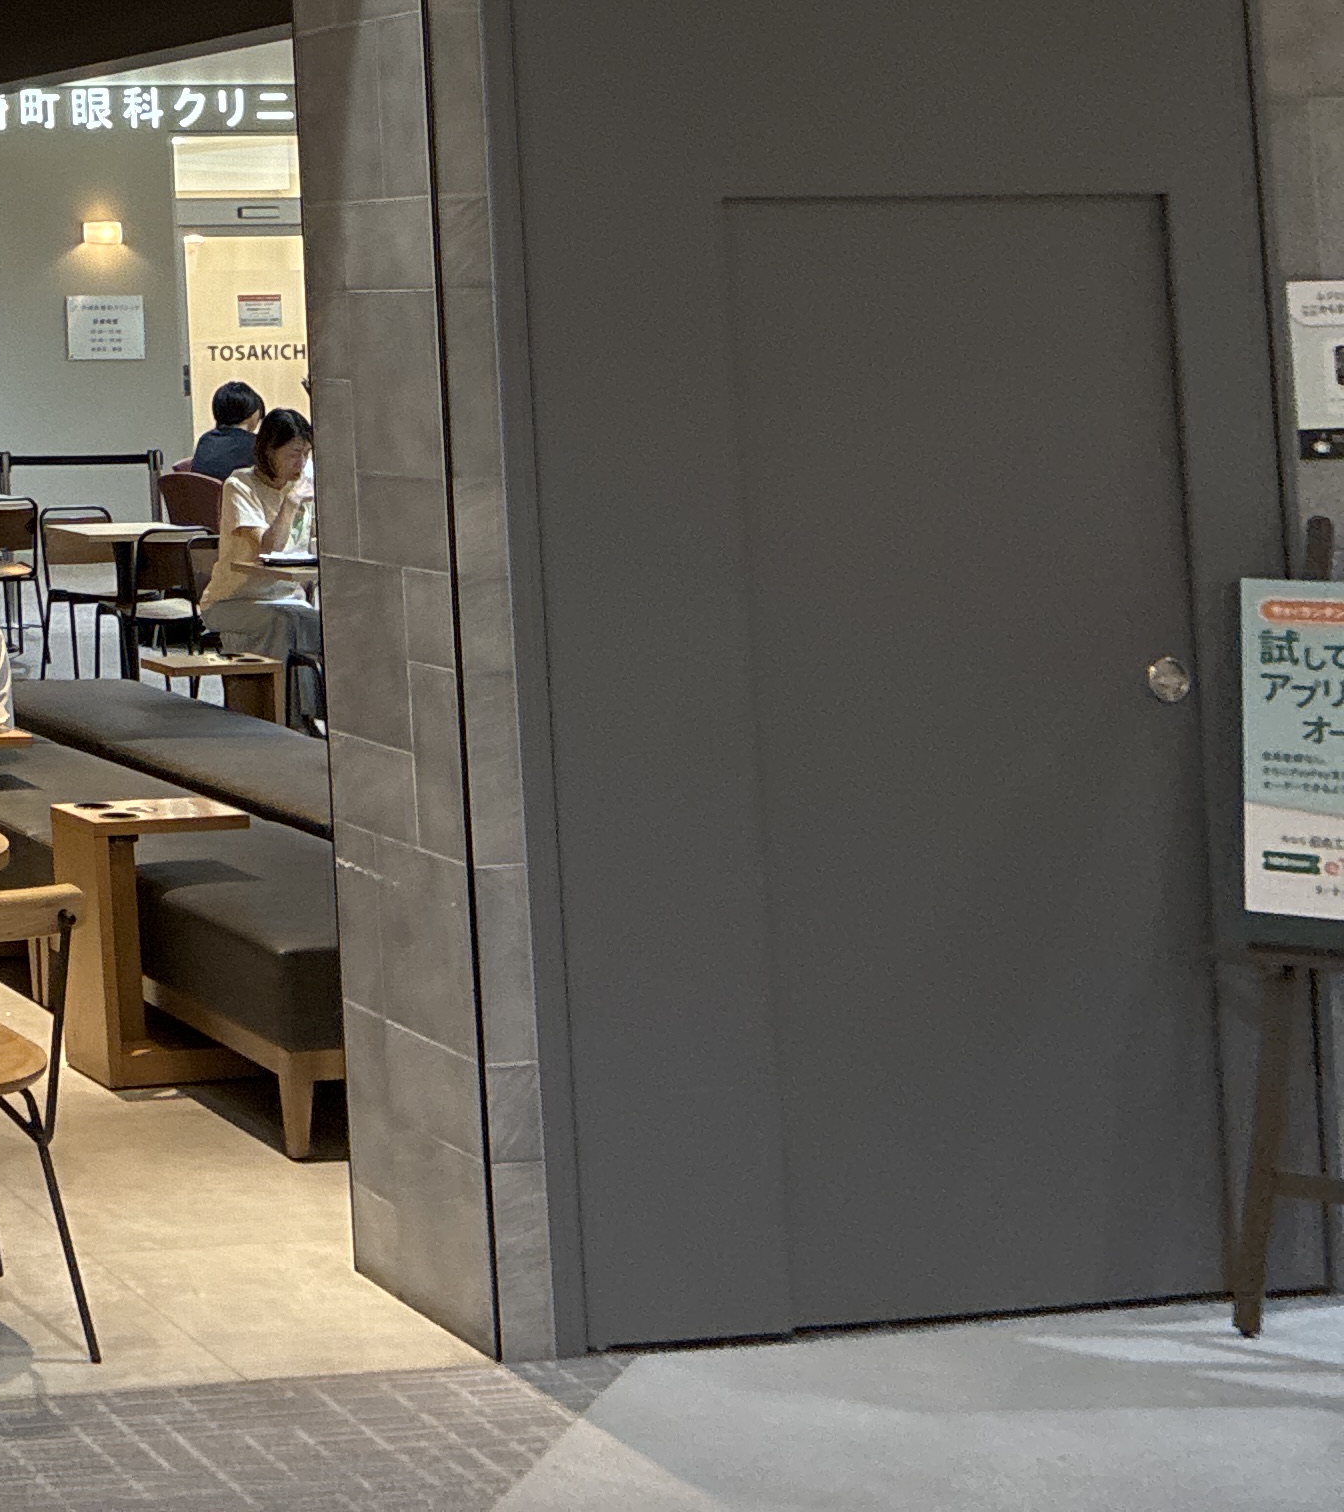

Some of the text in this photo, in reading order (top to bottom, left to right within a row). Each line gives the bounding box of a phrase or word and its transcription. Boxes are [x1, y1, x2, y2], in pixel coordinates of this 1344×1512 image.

[207, 343, 306, 361] TOSAKICH
[1258, 629, 1344, 670] 試して
